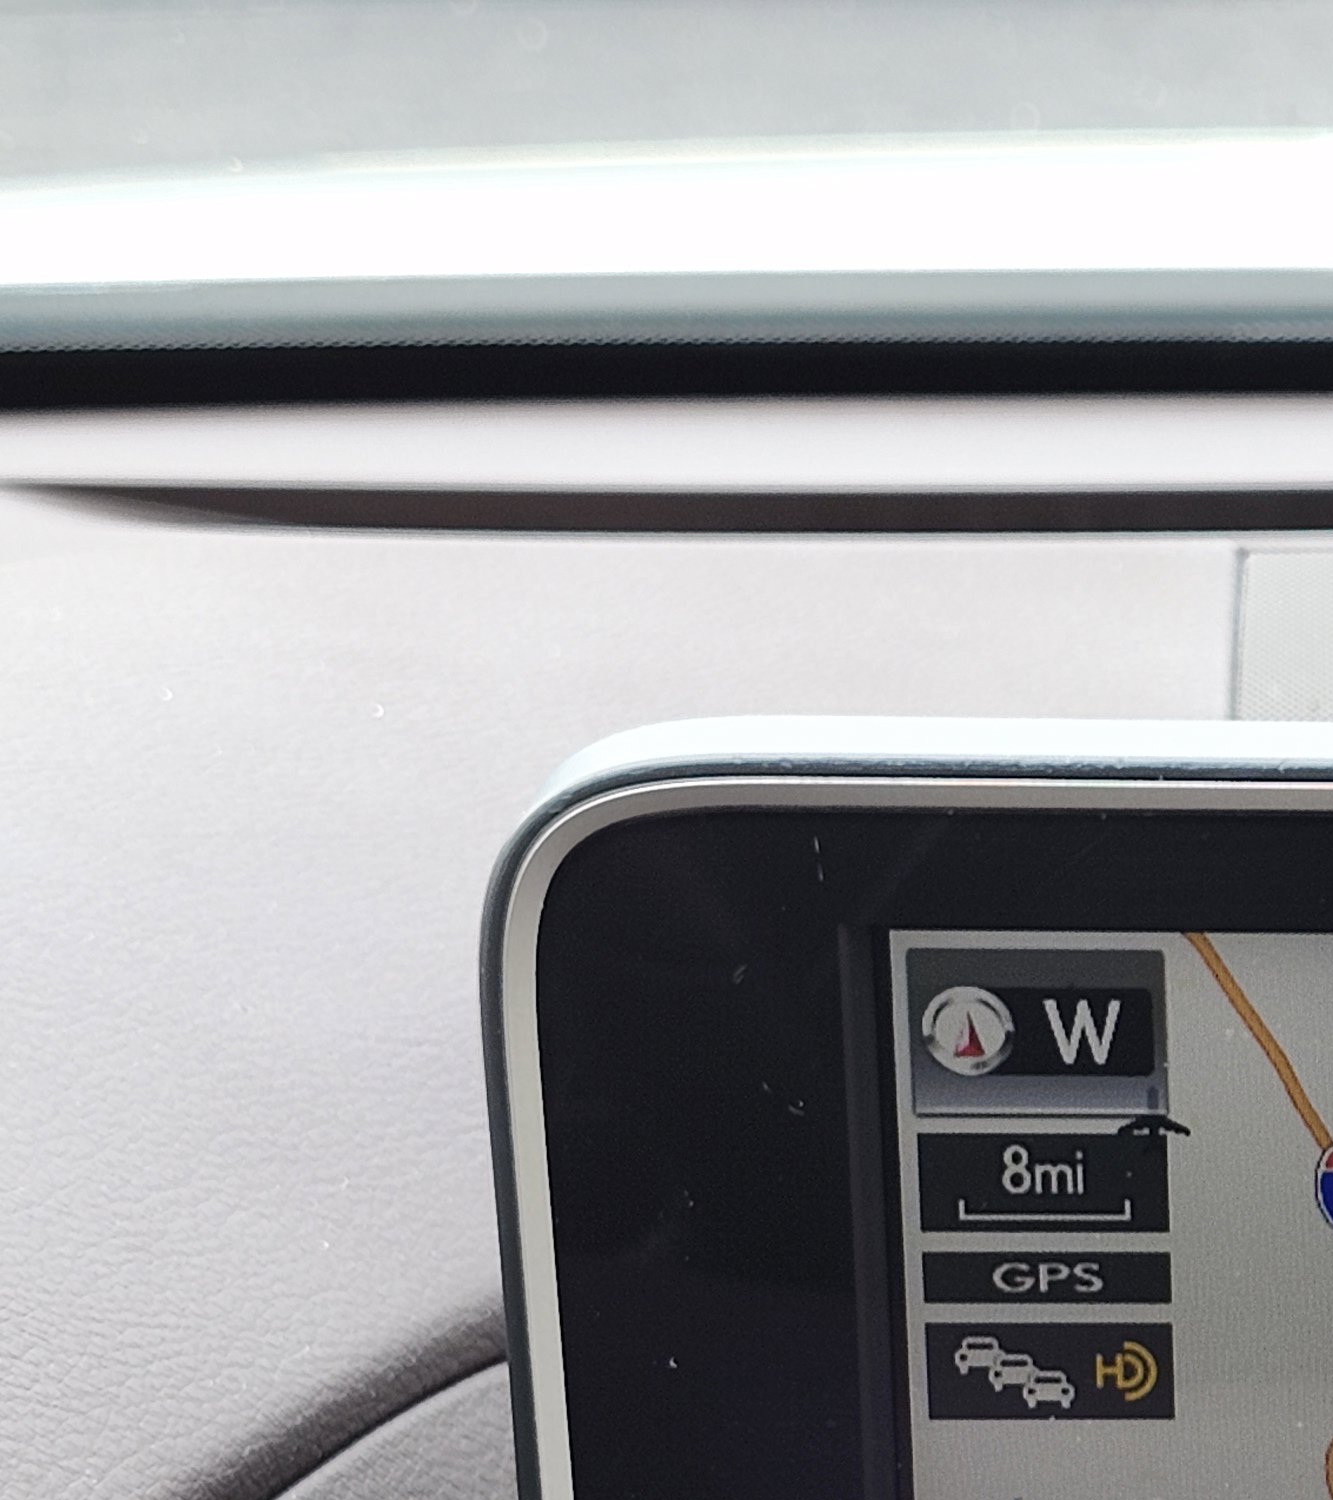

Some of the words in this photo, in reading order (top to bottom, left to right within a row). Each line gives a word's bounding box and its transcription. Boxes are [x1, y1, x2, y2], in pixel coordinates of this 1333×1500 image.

[1041, 998, 1121, 1066] W
[1001, 1144, 1086, 1196] 8mi
[991, 1262, 1104, 1293] GPS
